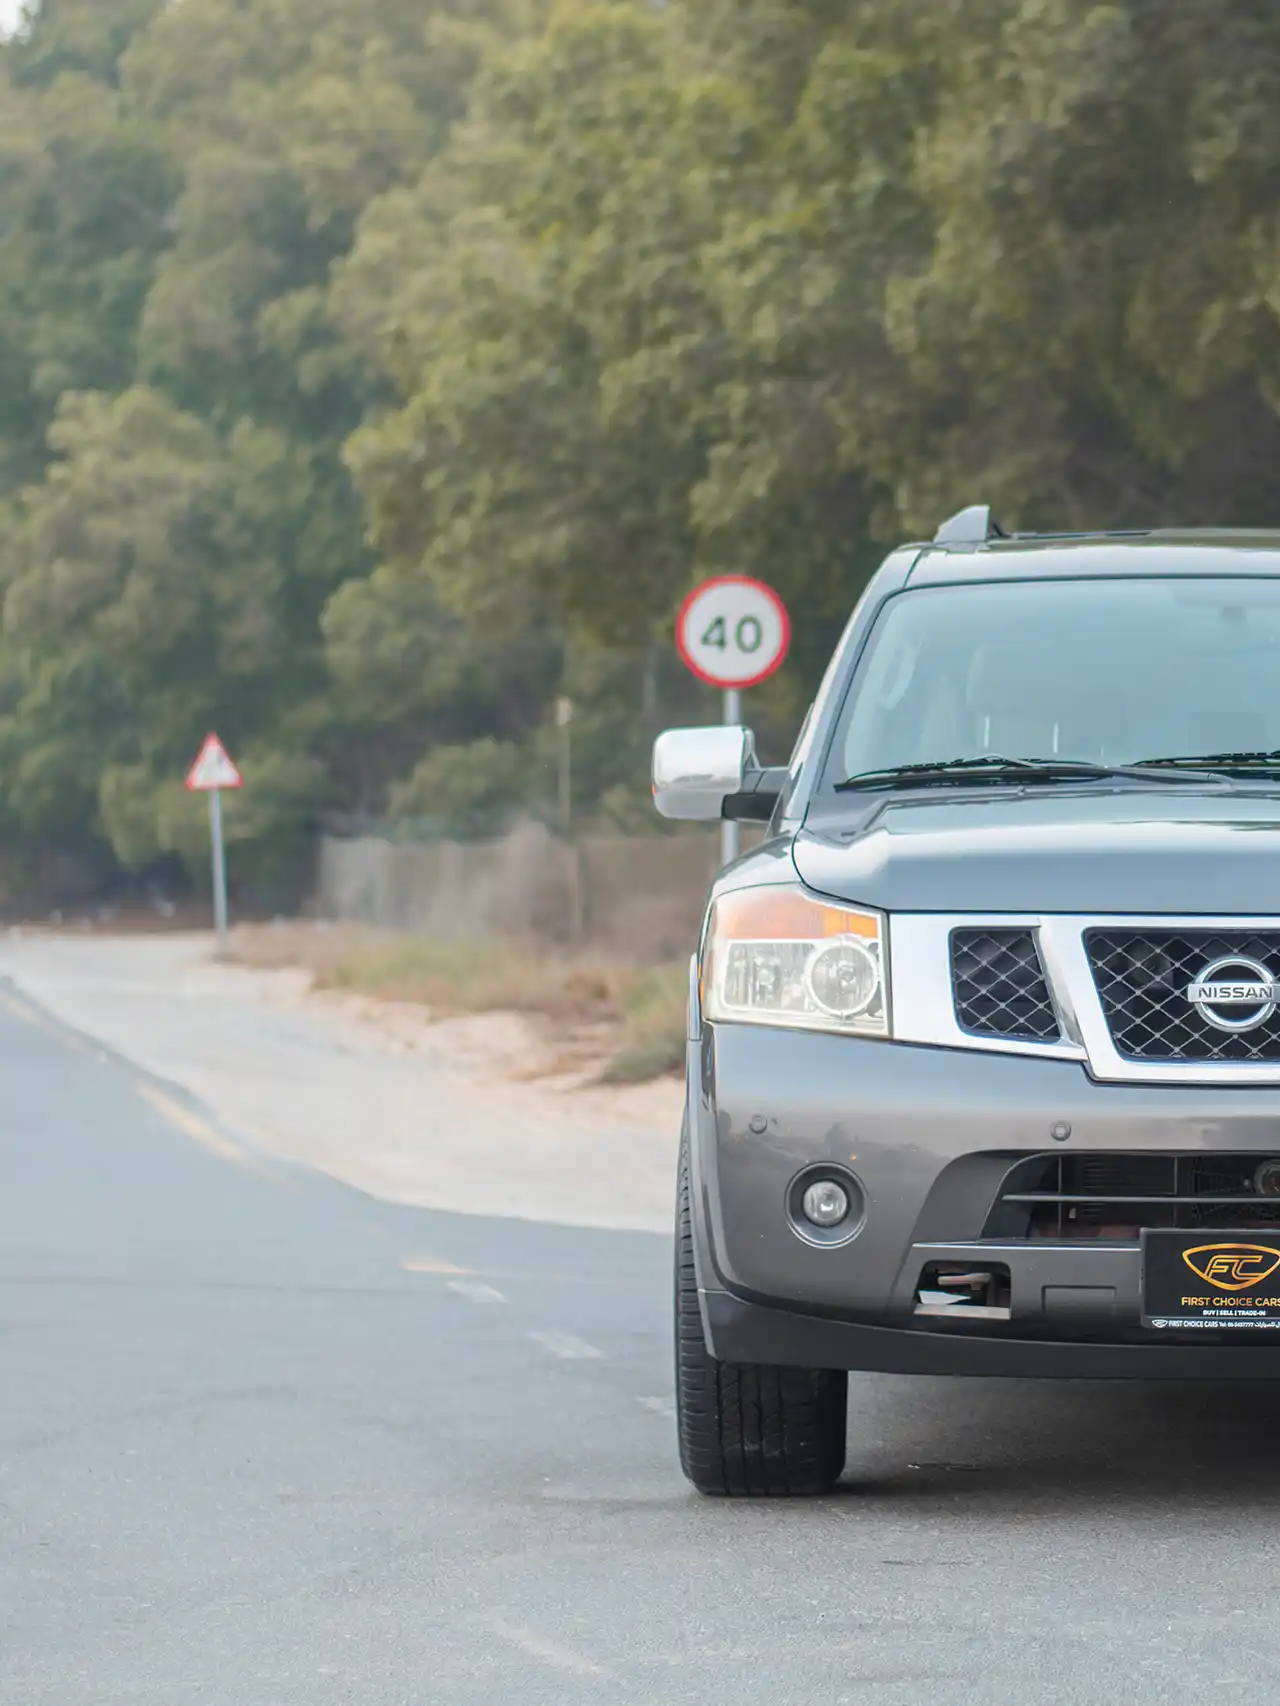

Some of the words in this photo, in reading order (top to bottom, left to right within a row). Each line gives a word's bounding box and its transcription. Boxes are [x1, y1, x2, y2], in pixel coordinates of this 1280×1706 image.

[701, 616, 762, 653] 40
[1198, 986, 1273, 998] NISSAN
[1181, 1297, 1210, 1306] FIRST
[1212, 1297, 1253, 1306] CHOICE
[1169, 1320, 1182, 1328] FIRST
[1183, 1320, 1203, 1328] CHOICE
[1204, 1320, 1218, 1328] CARS
